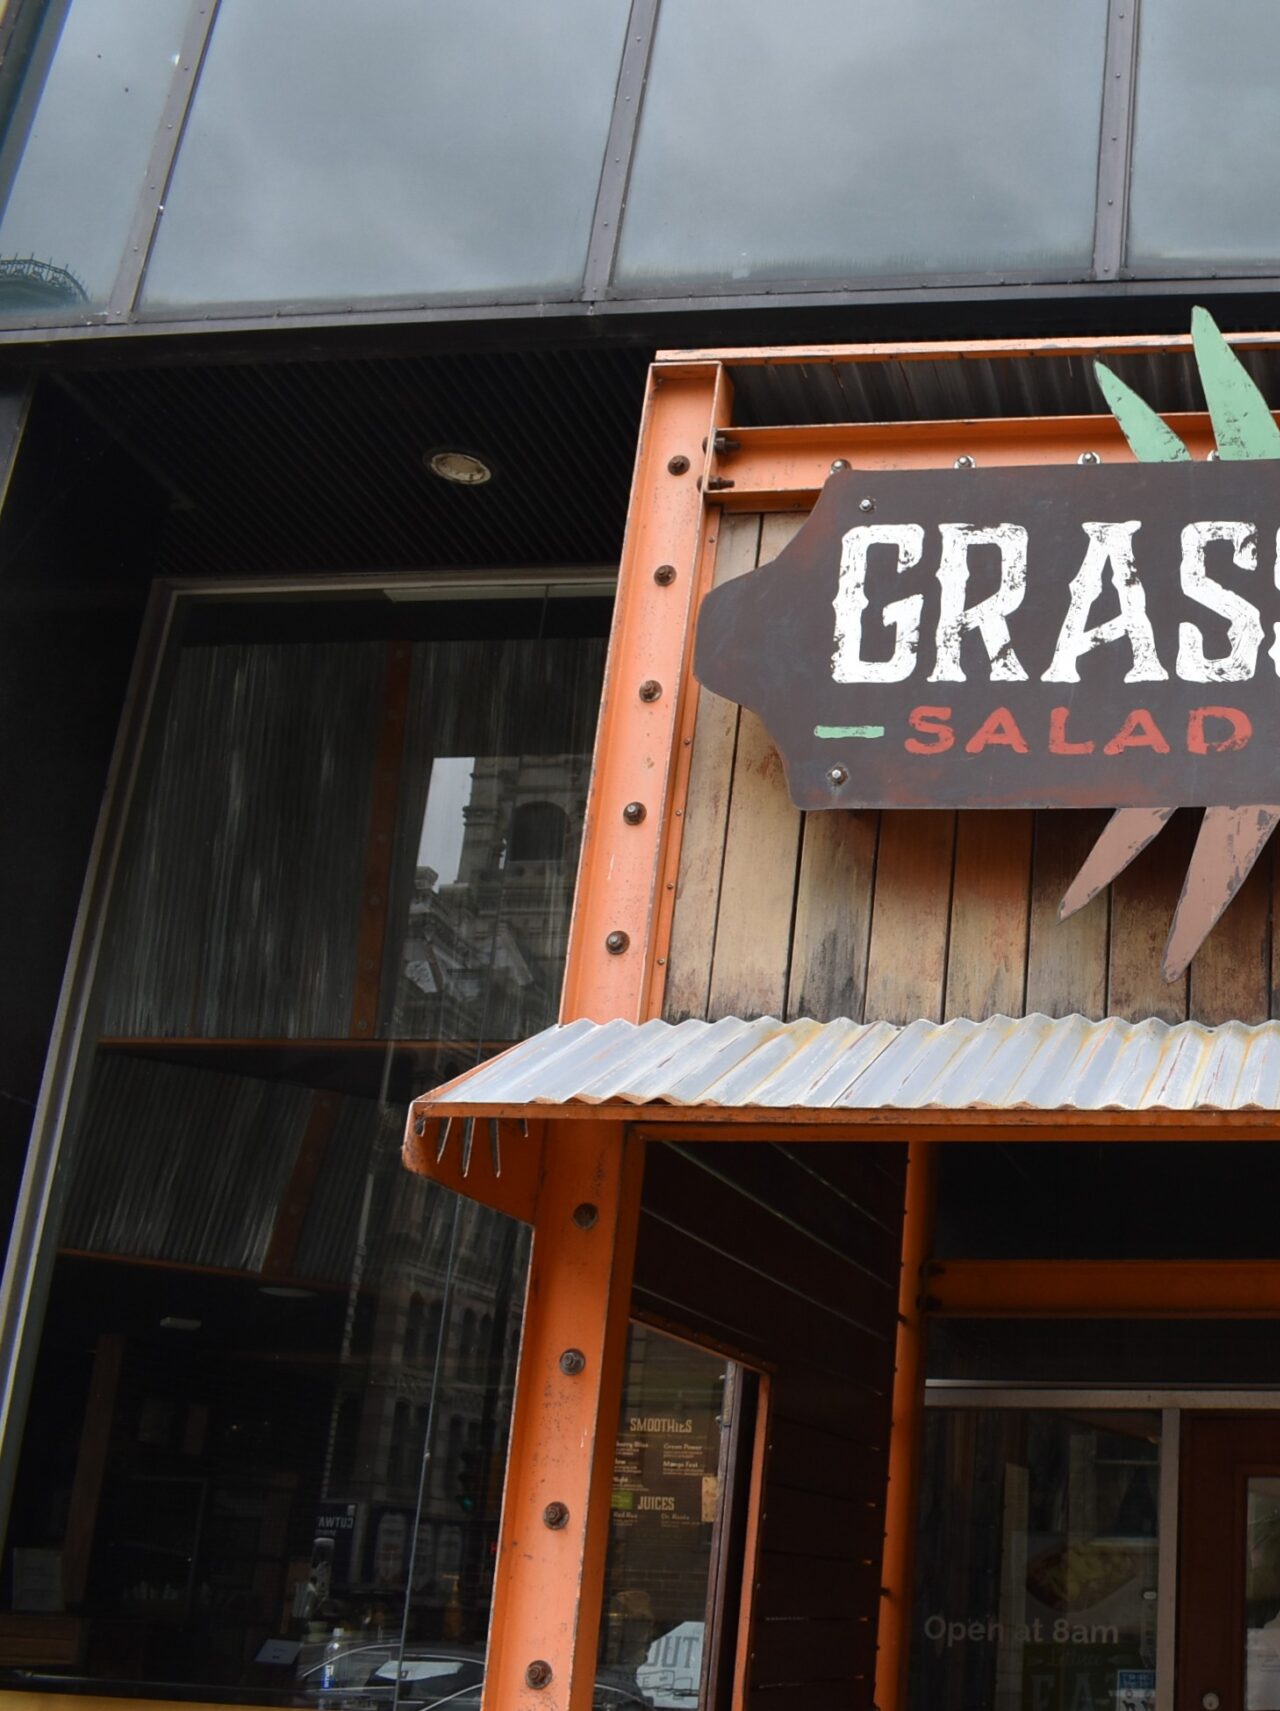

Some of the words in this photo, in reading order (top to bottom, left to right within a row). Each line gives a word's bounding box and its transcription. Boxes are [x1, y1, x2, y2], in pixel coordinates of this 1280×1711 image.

[904, 705, 1253, 756] SALAD
[630, 1418, 692, 1433] SMOOTHIES
[637, 1497, 675, 1510] JUICES
[924, 1616, 1004, 1648] Open
[1014, 1617, 1043, 1643] at
[1052, 1617, 1120, 1645] 8am
